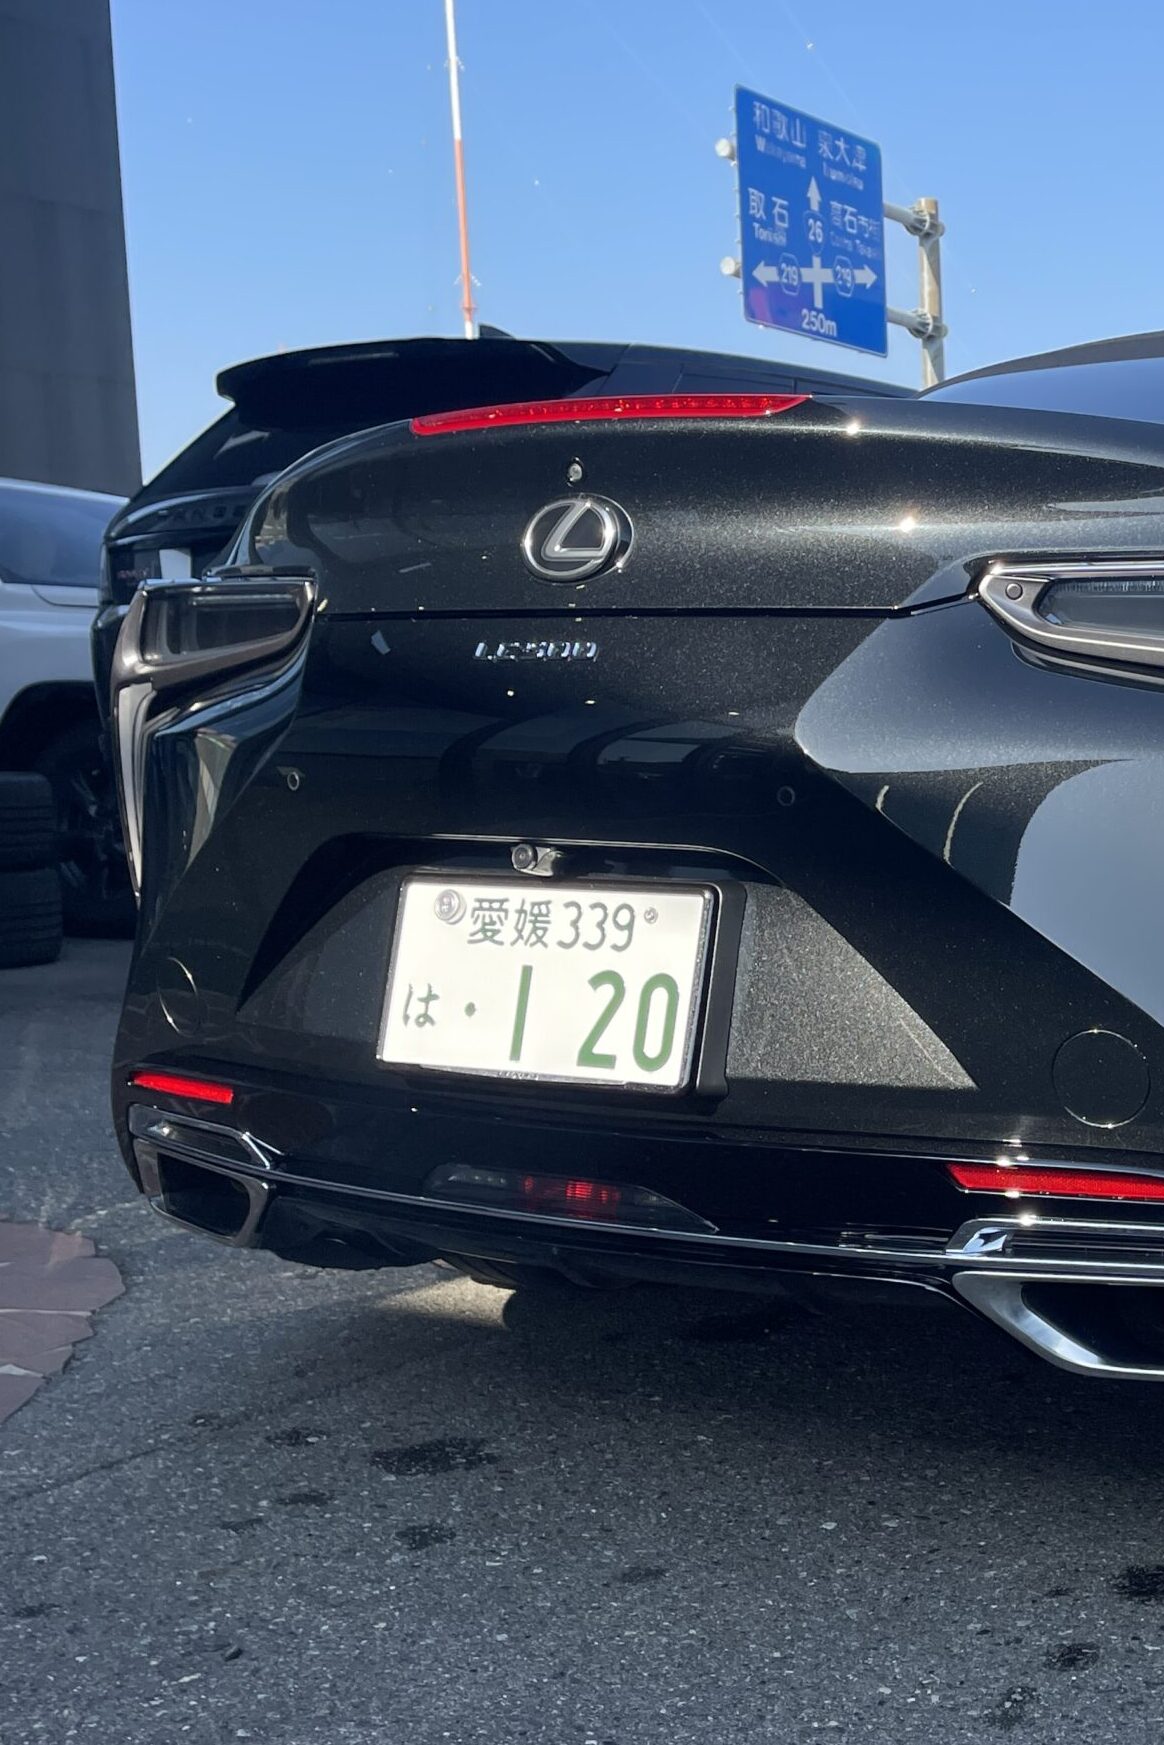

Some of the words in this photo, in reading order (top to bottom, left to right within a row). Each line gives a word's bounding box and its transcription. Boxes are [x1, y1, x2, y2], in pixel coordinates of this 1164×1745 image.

[753, 101, 806, 148] 和歌山
[748, 187, 789, 228] 取石
[808, 218, 823, 243] 26
[780, 262, 799, 286] 219
[801, 308, 837, 337] 250m
[473, 641, 598, 662] LC500
[402, 983, 440, 1028] は
